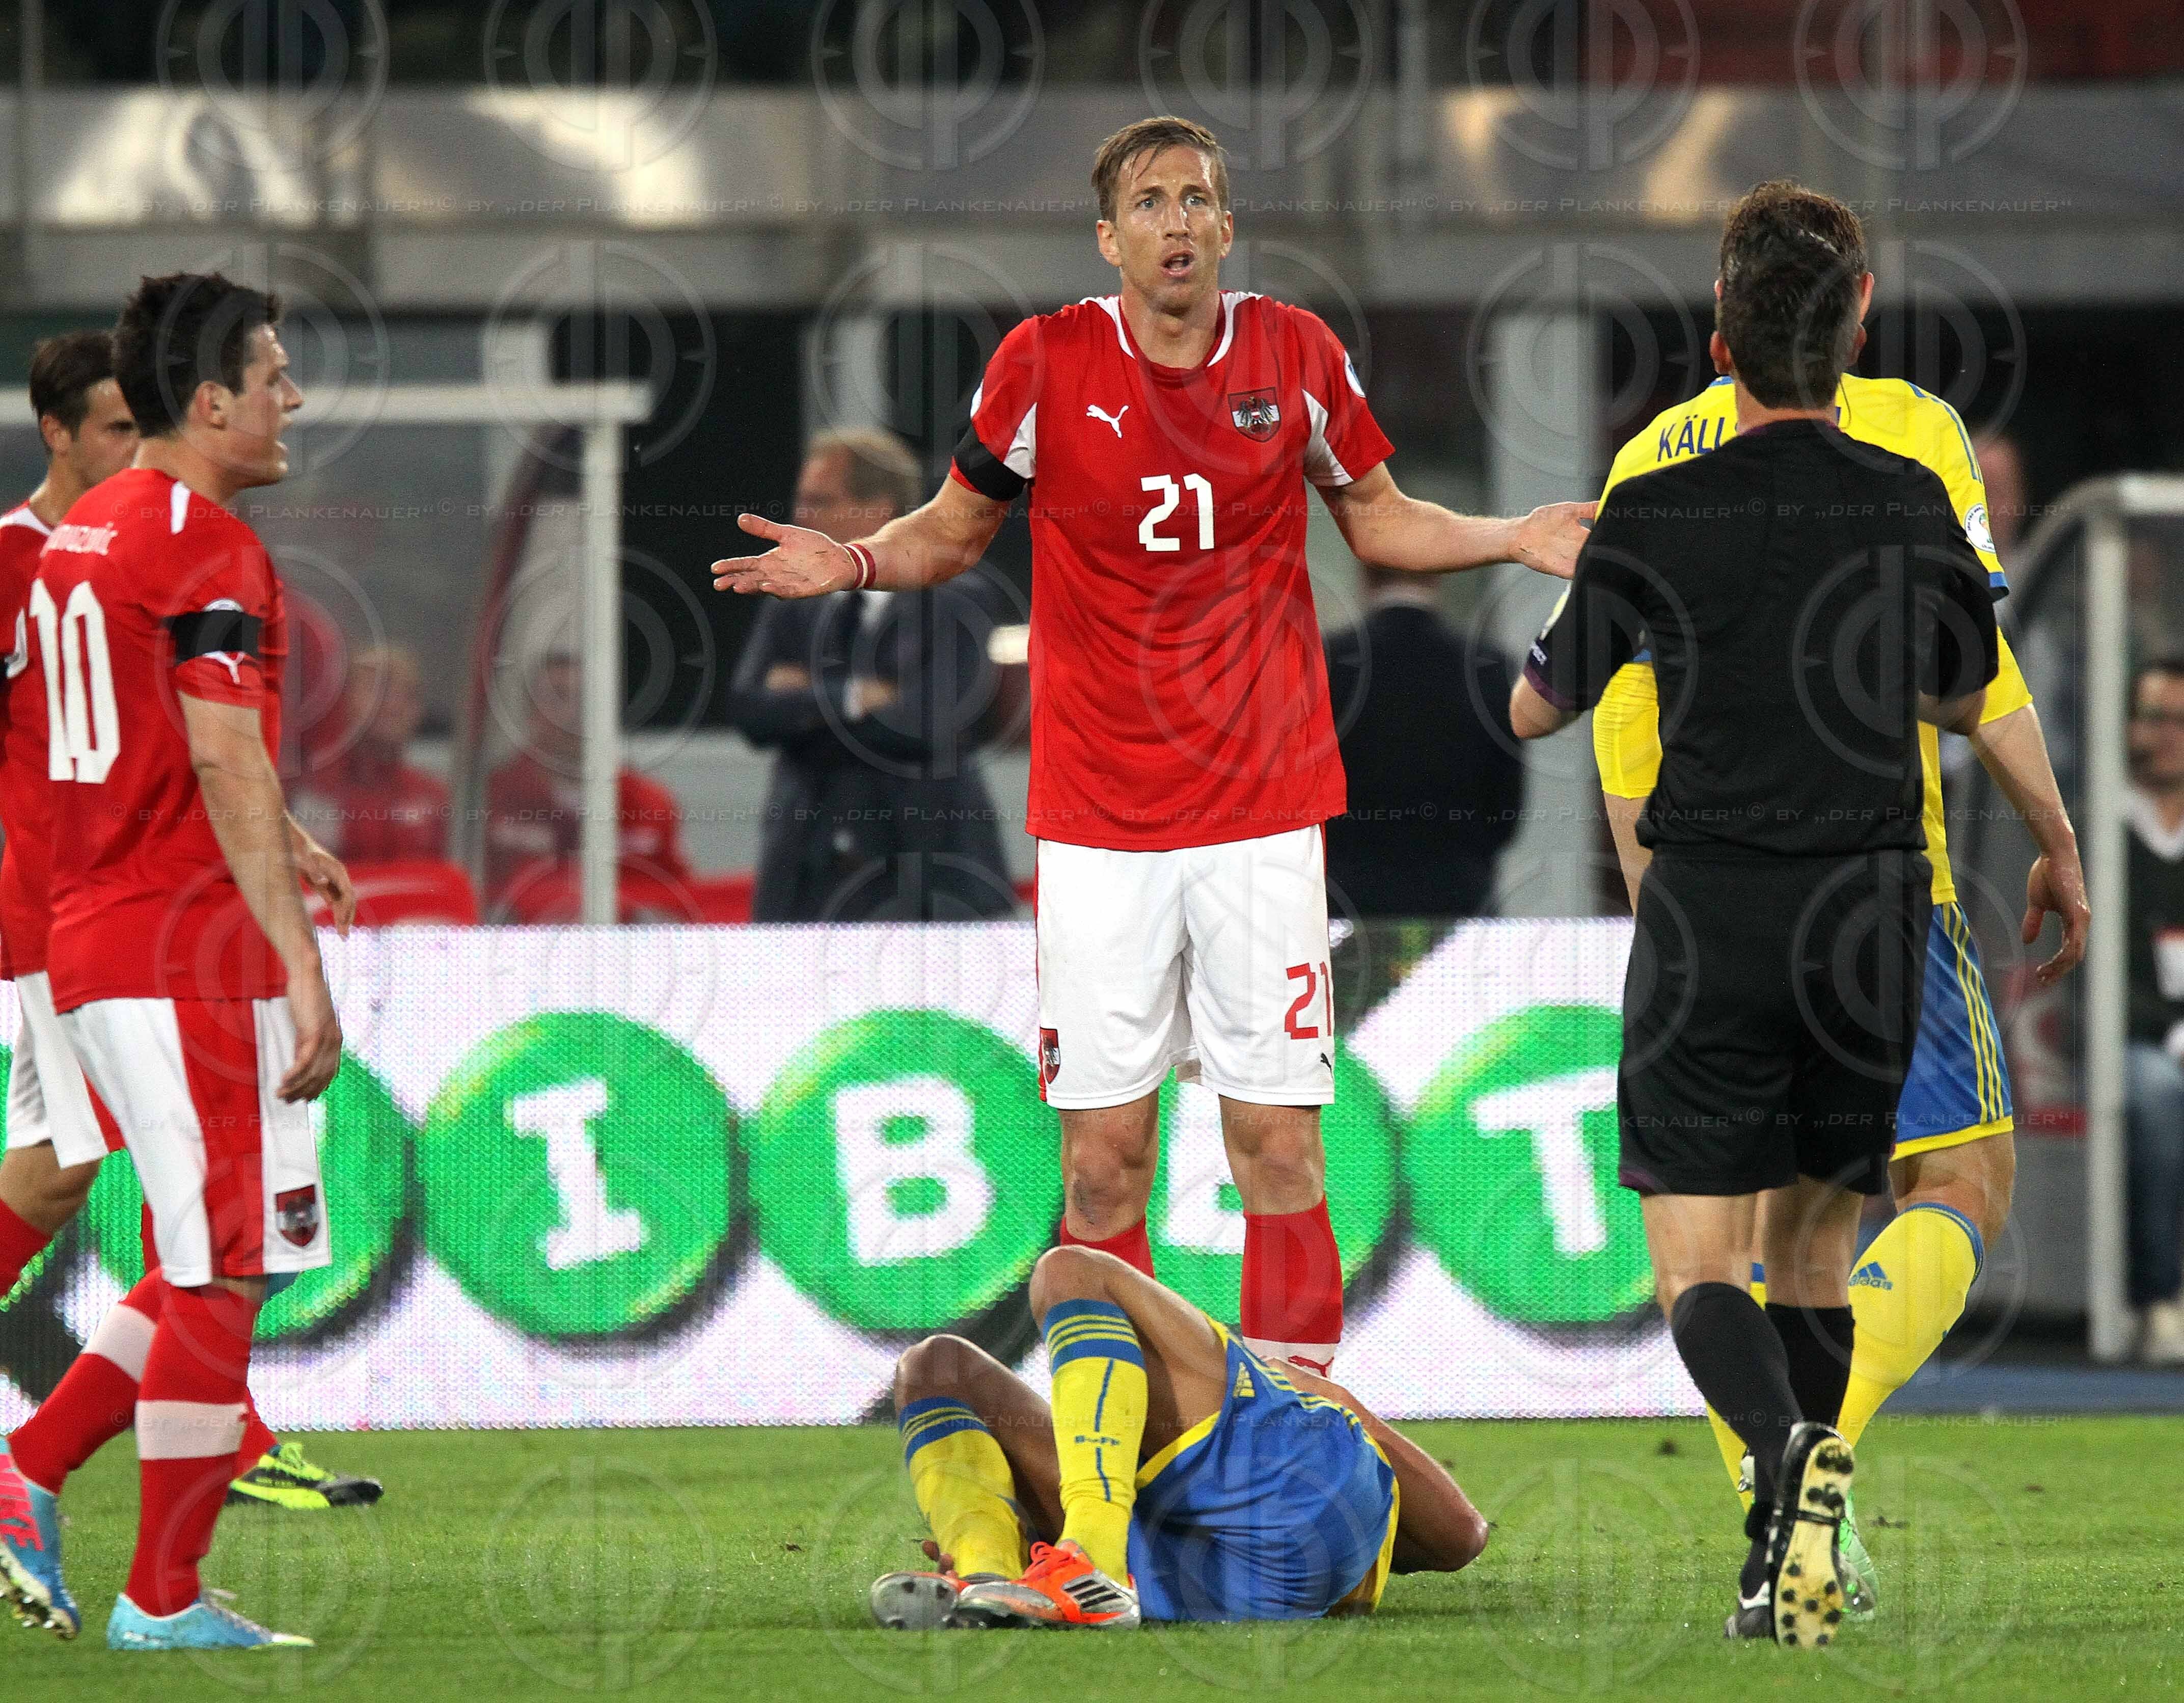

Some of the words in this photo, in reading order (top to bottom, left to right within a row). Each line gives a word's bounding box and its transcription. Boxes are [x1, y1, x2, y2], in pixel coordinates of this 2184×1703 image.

[1657, 414, 1738, 462] KÄLL
[1138, 473, 1214, 551] 21
[29, 577, 121, 784] 10
